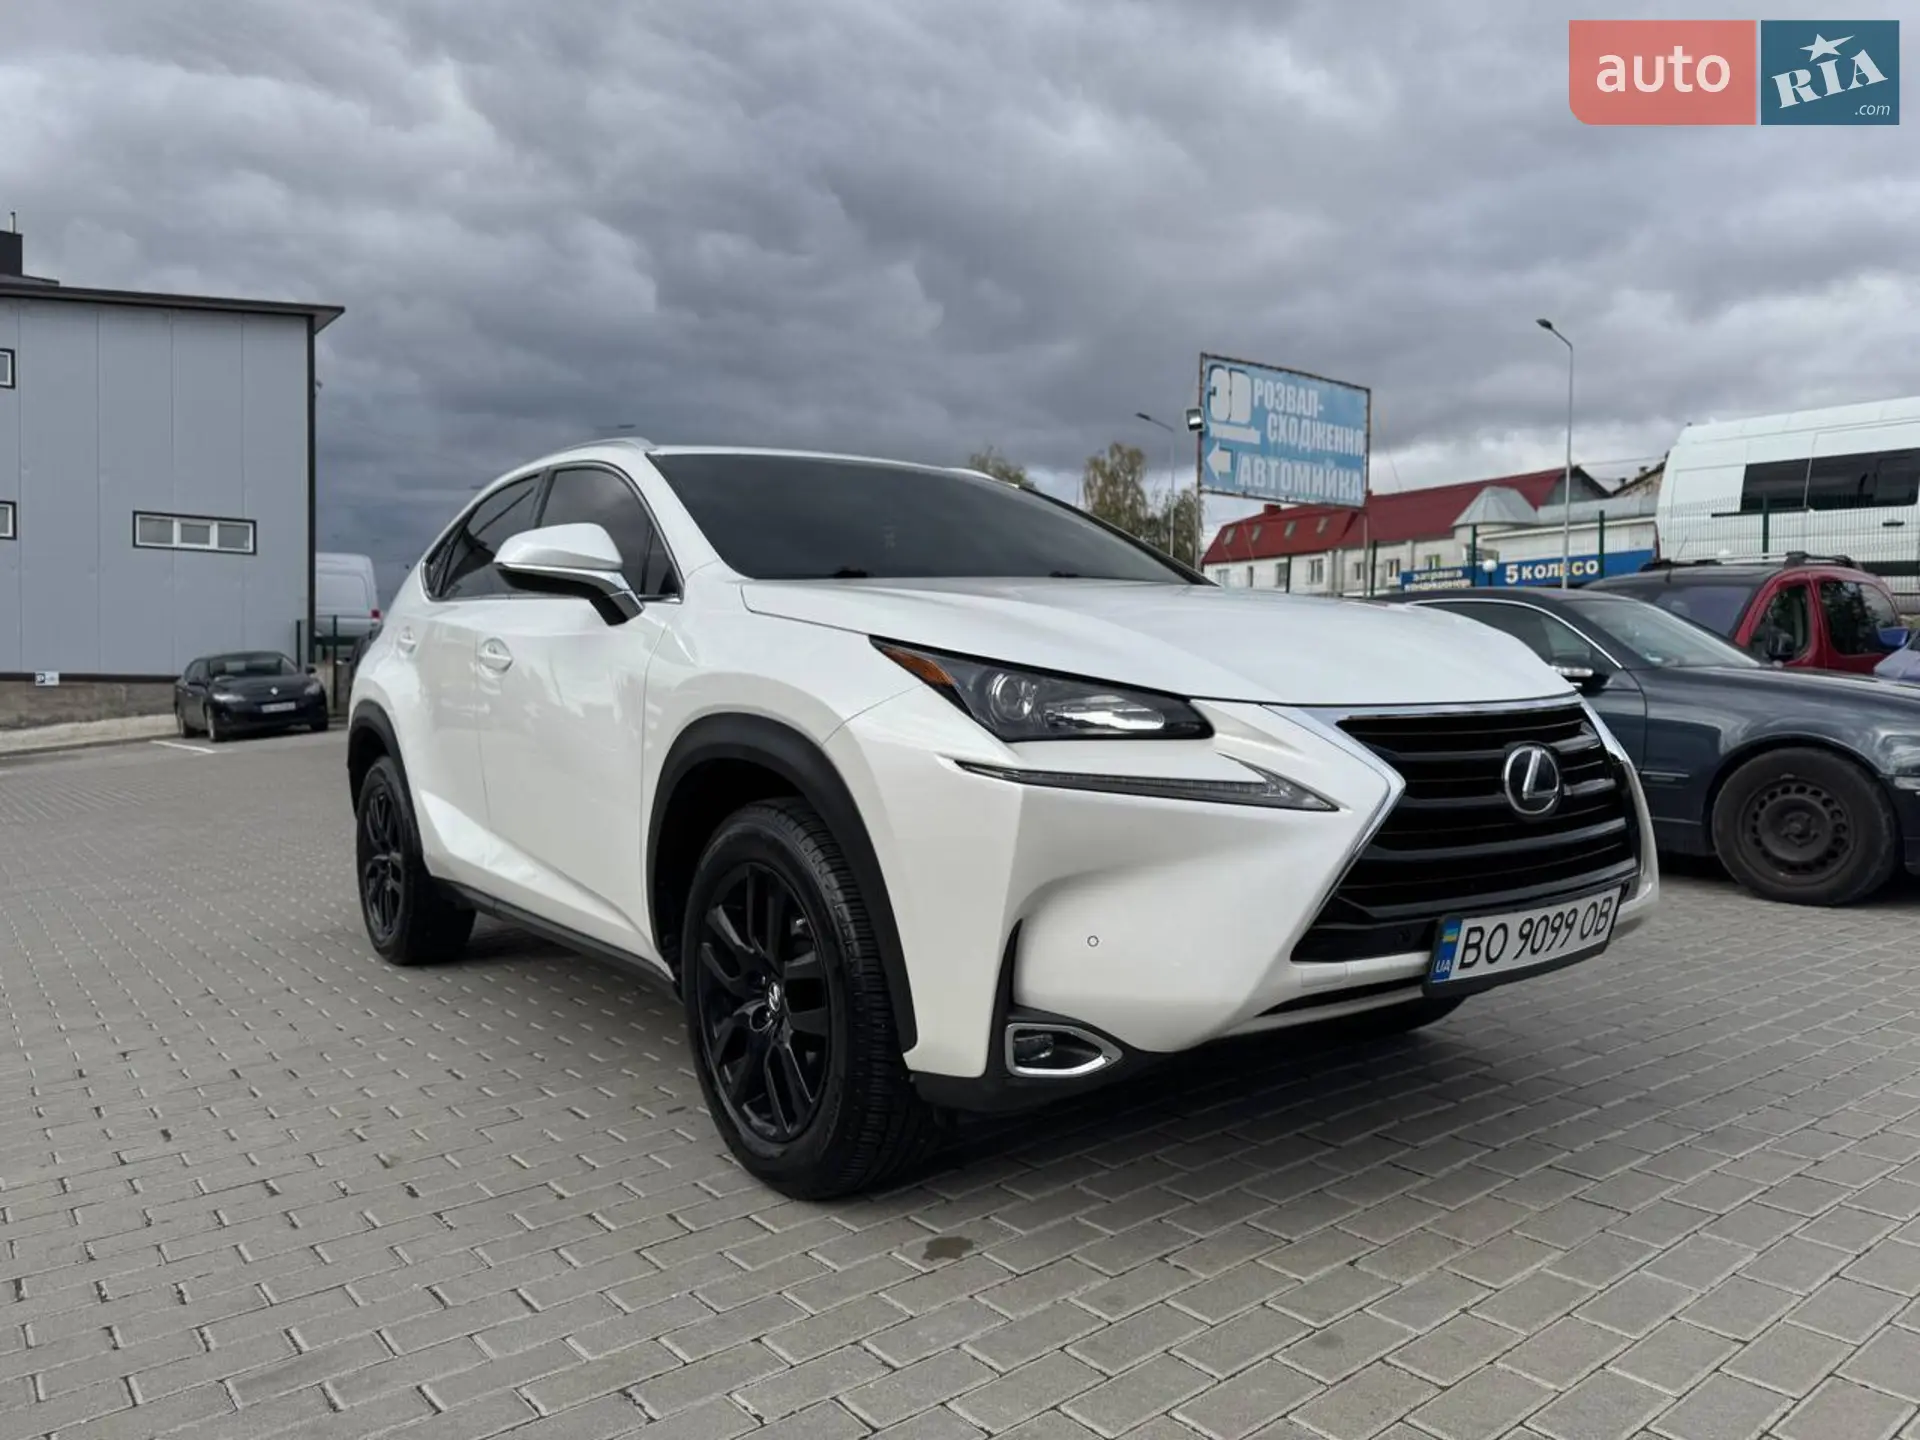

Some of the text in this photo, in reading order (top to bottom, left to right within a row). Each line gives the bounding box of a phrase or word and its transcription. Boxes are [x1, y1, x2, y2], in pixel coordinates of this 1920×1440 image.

[1253, 377, 1325, 418] РОЗВАЛ-
[1267, 412, 1364, 456] СХОДЖЕННЯ
[1237, 452, 1362, 500] АВТОМИЙКА
[1505, 563, 1519, 584] 5
[1458, 896, 1613, 970] BO 9099 OB
[1435, 959, 1450, 973] UA
